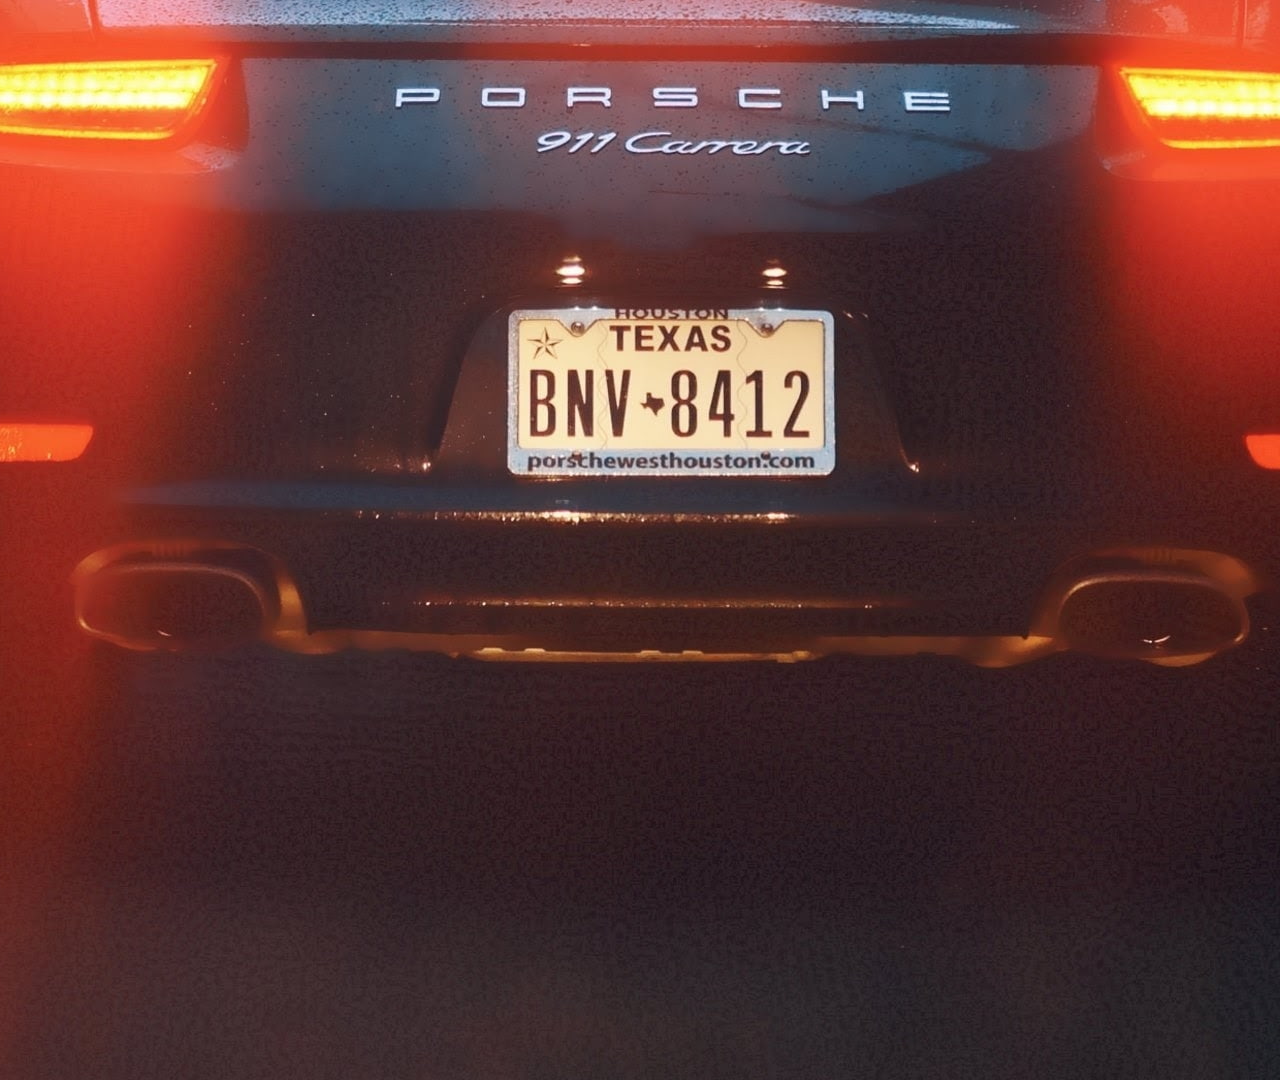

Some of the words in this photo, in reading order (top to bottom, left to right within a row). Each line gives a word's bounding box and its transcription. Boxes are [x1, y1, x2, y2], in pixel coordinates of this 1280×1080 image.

[394, 87, 951, 112] PORSCHE
[536, 131, 617, 154] 911
[625, 132, 812, 155] Carrera
[615, 308, 729, 320] HOUSTON
[609, 325, 732, 352] TEXAS
[527, 452, 815, 471] porschewesthouston.com
